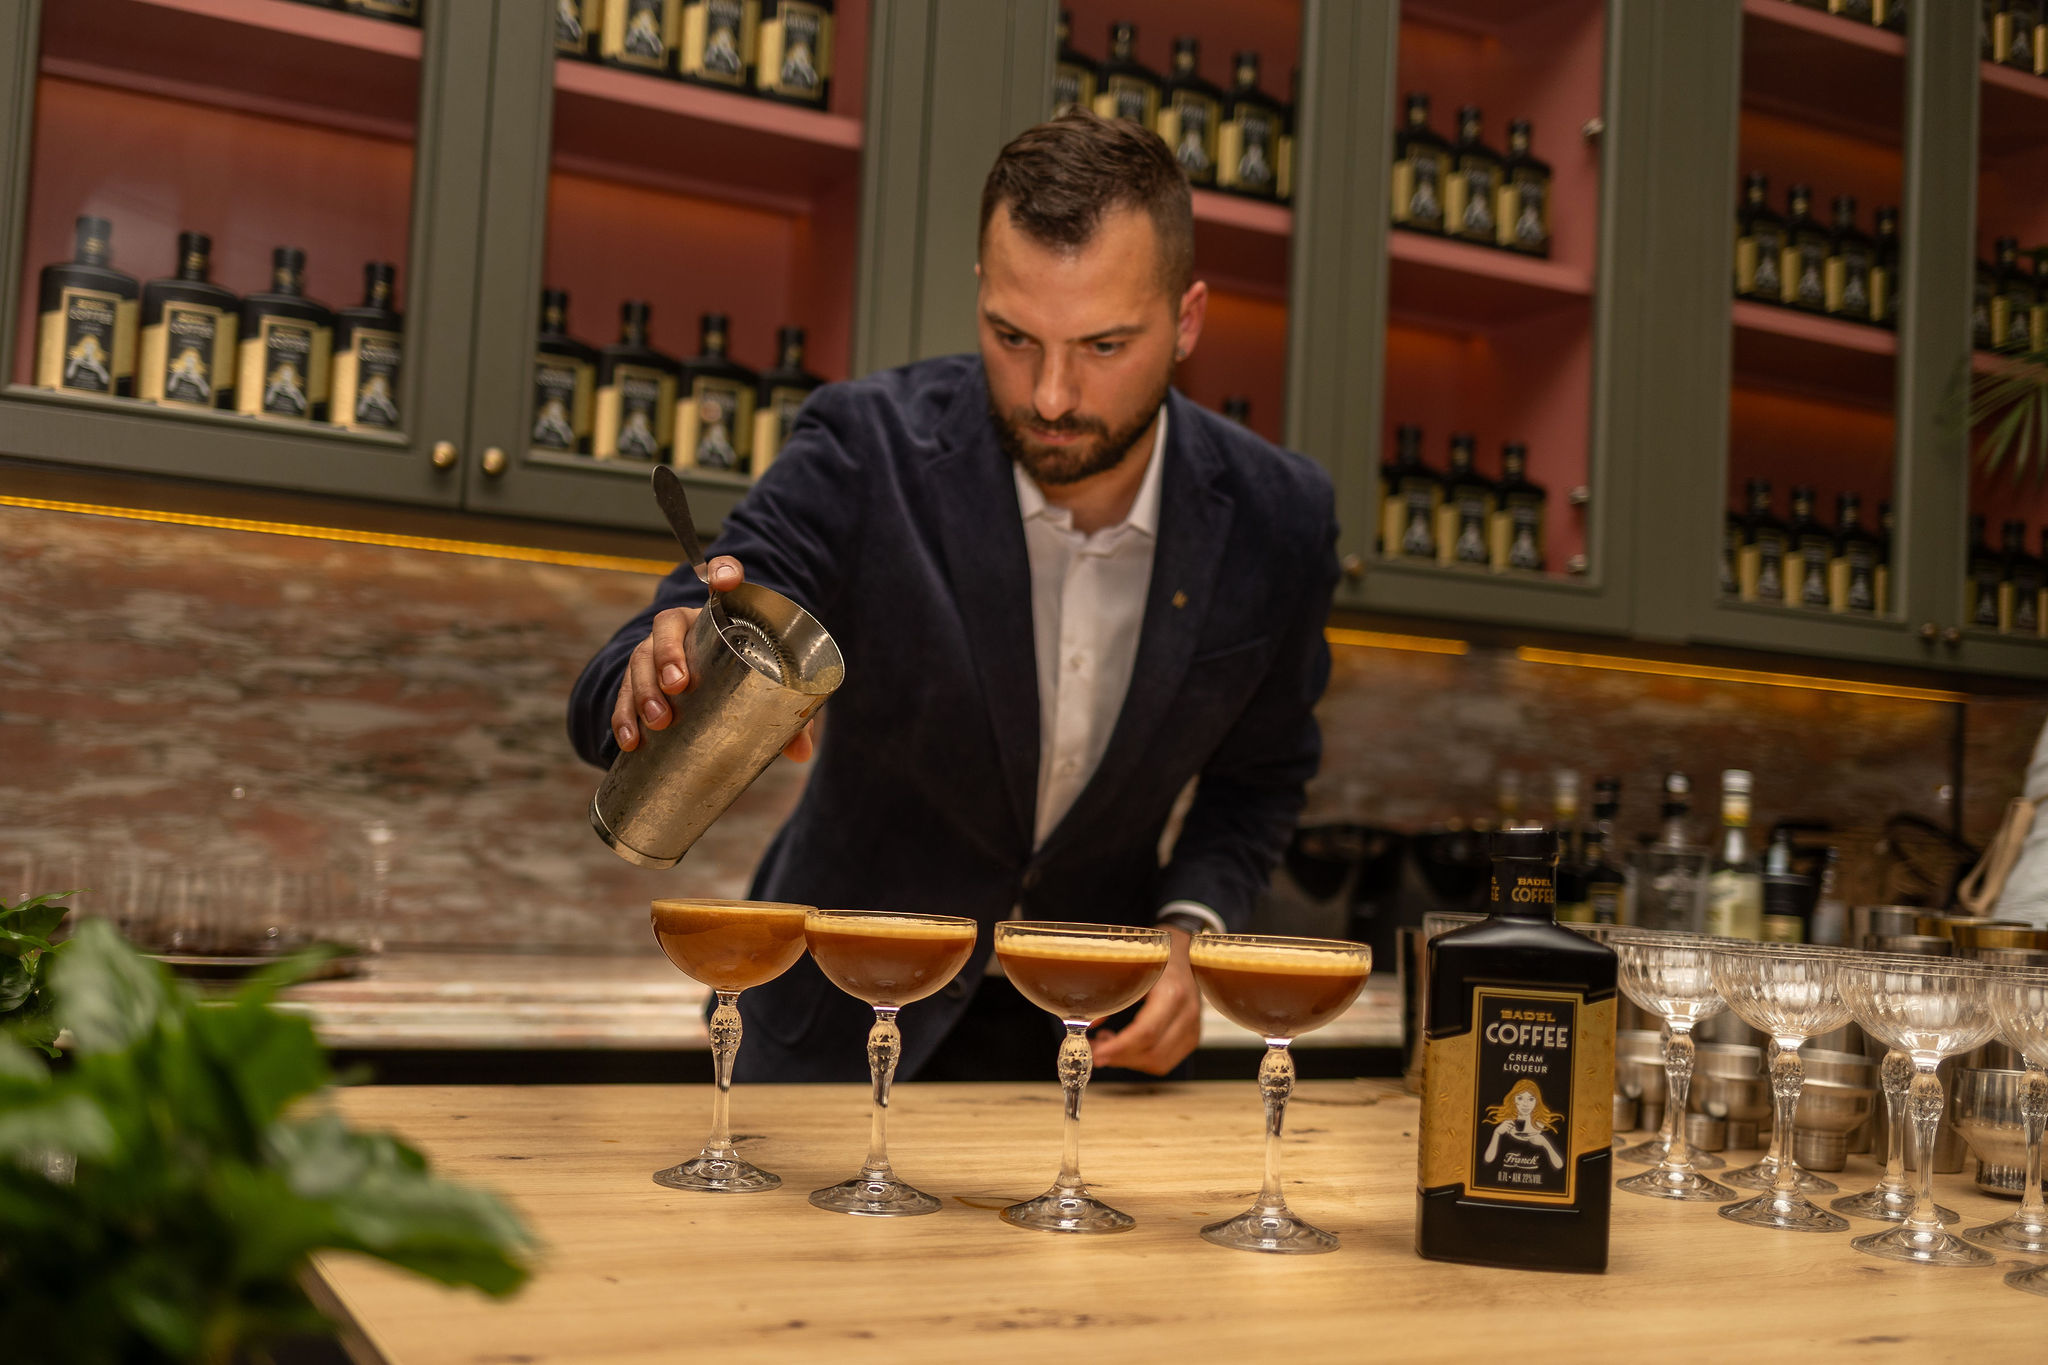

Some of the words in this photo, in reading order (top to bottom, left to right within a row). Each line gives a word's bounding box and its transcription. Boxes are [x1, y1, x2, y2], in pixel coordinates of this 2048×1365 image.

[1517, 877, 1552, 887] BADEL
[1511, 887, 1554, 903] COFFEE
[1501, 1010, 1556, 1022] BADEL
[1486, 1023, 1568, 1048] COFFEE
[1508, 1053, 1544, 1063] CREAM
[1503, 1063, 1548, 1073] LIQUEUR
[1503, 1152, 1539, 1165] Franck
